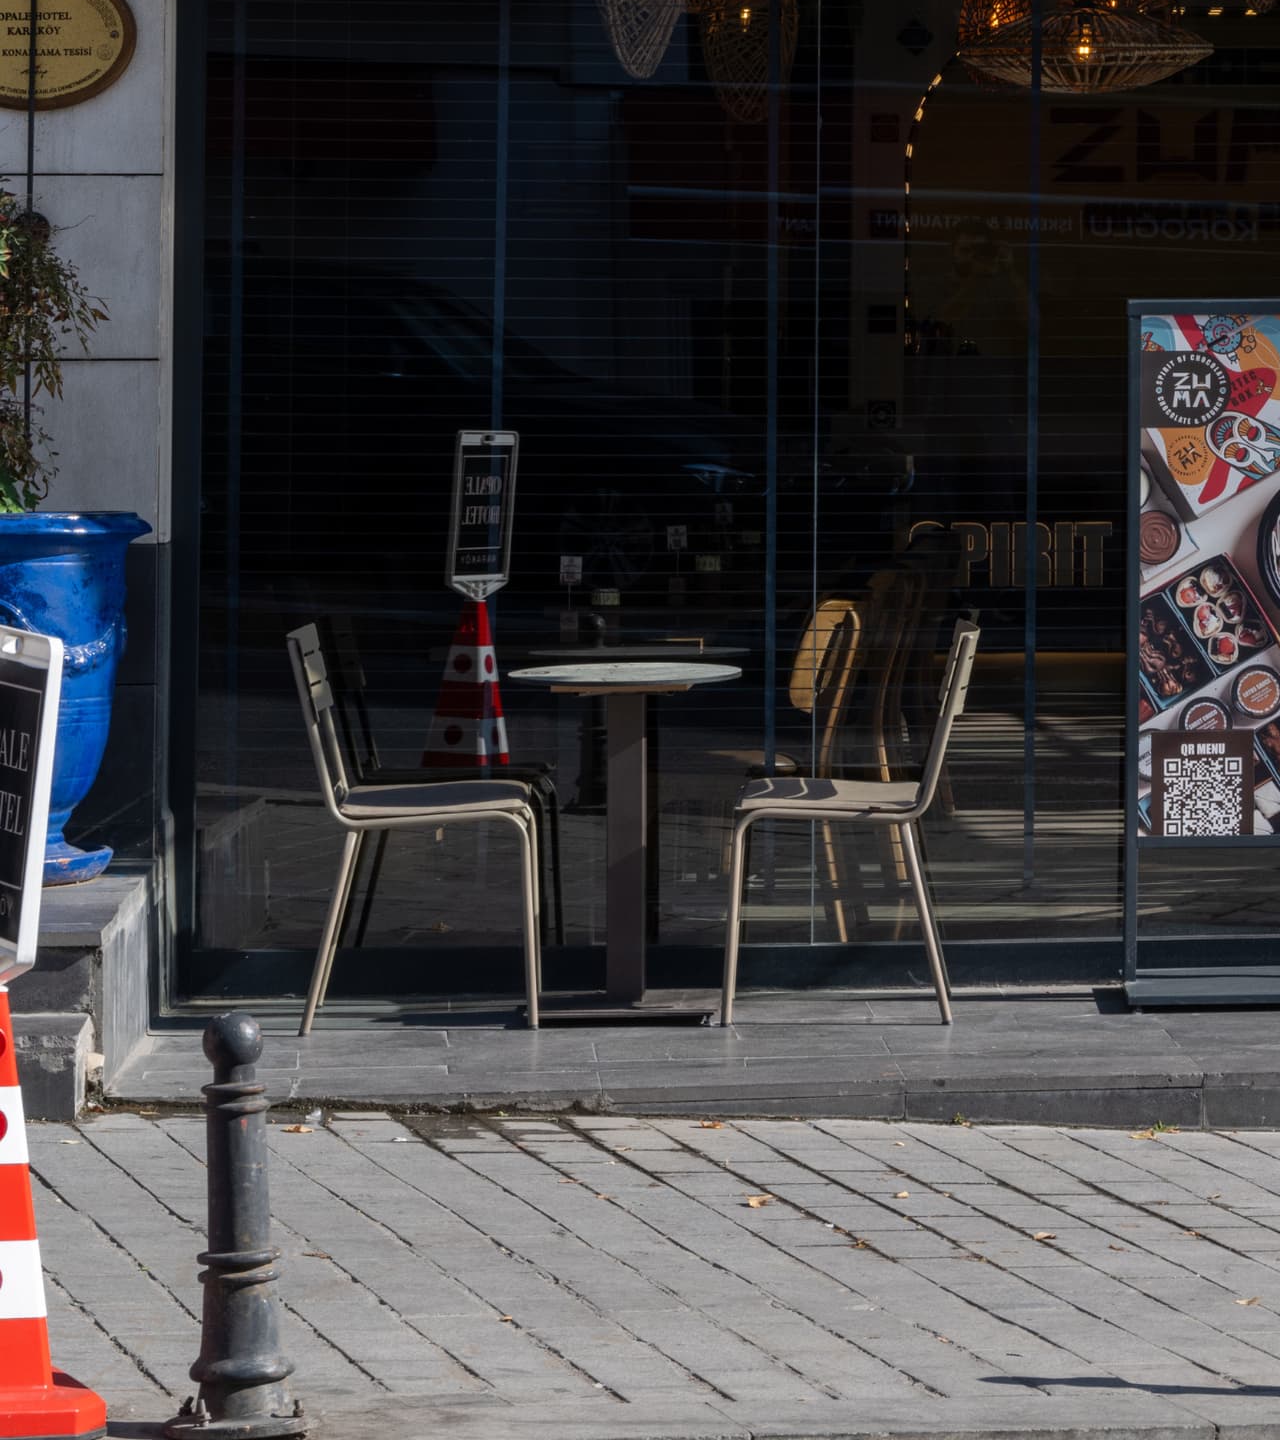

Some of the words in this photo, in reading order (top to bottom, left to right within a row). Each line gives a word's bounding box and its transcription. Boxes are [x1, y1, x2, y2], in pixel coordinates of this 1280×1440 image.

[7, 24, 61, 36] KARKÖY
[2, 48, 61, 57] KONALAMA
[1190, 353, 1228, 385] CHOCOLATE
[1180, 743, 1196, 756] QR
[1197, 743, 1226, 755] MENU
